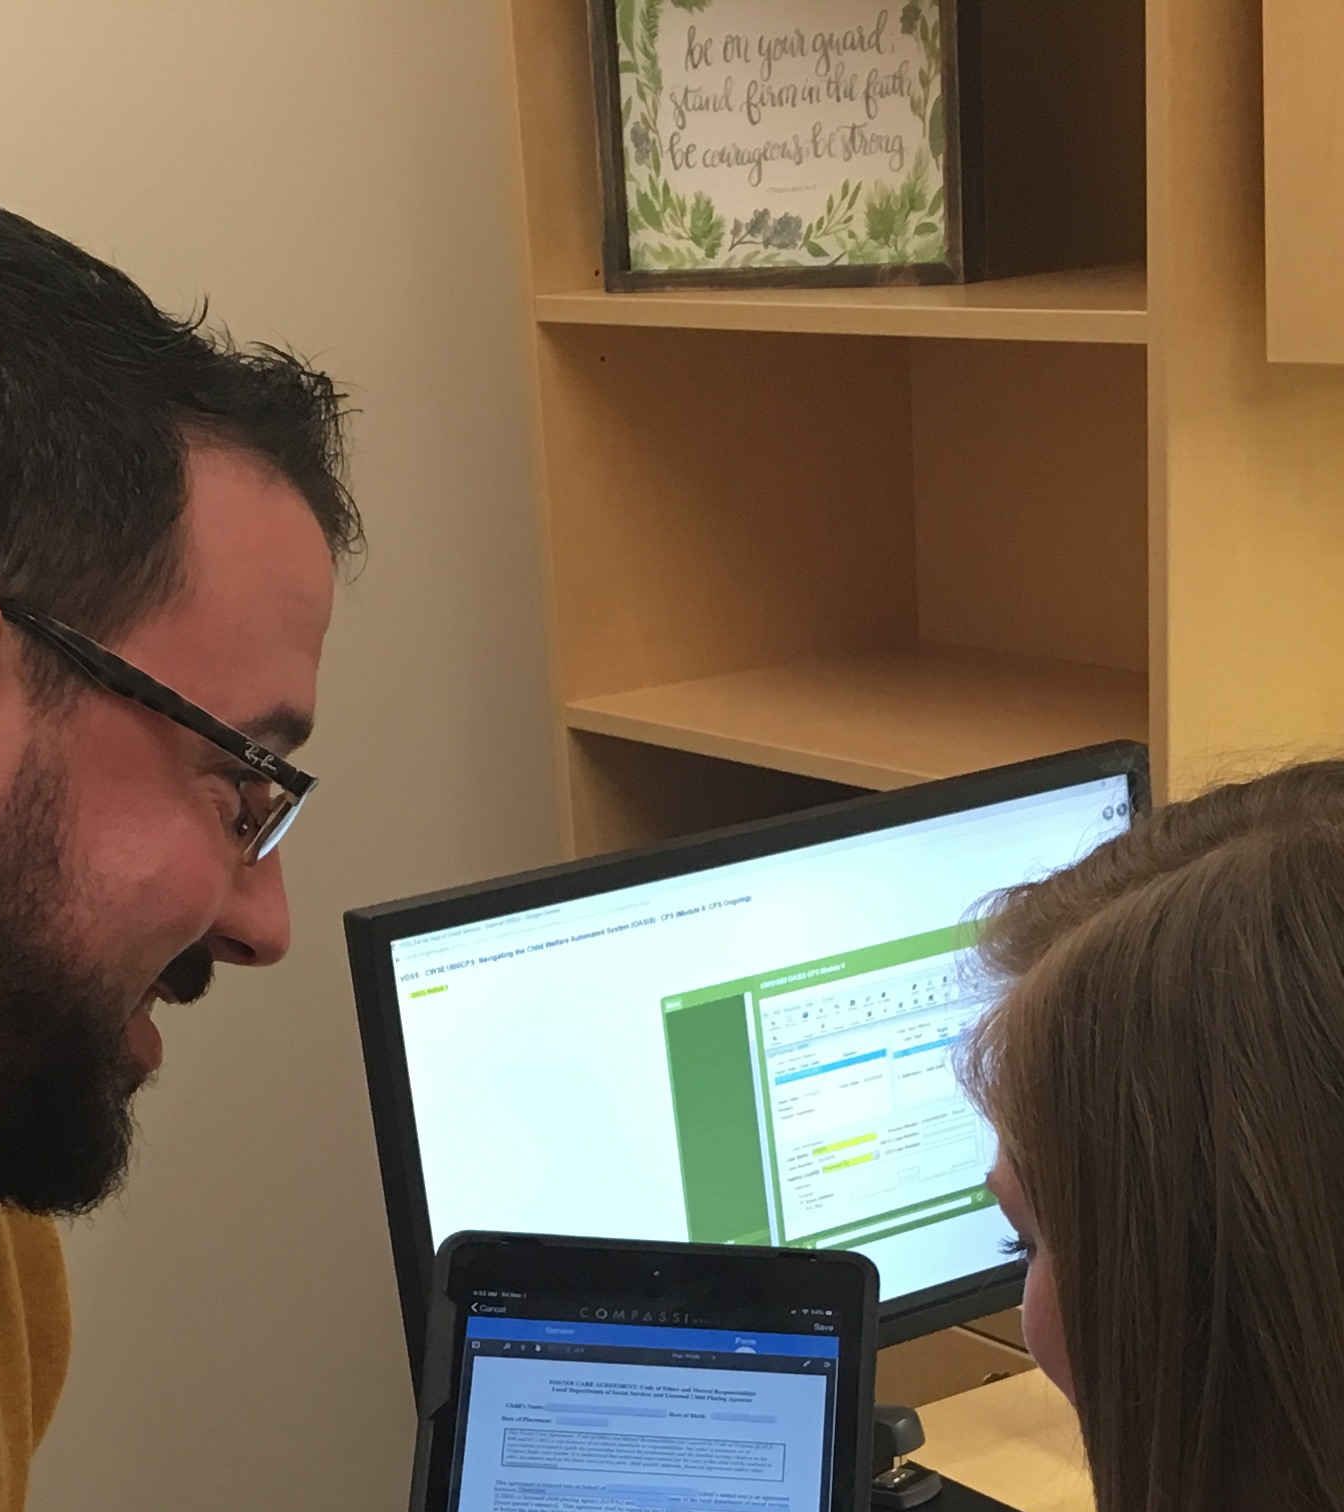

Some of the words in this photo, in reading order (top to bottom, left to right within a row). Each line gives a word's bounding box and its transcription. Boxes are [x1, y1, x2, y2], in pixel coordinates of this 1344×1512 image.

[685, 24, 713, 72] be
[723, 34, 750, 63] on
[758, 28, 807, 82] your
[669, 75, 734, 130] stand
[740, 80, 797, 125] firm
[801, 78, 821, 105] in
[824, 61, 858, 103] the
[668, 131, 698, 171] be
[811, 121, 837, 158] be
[399, 970, 419, 983] VDSS
[478, 949, 514, 966] Navigating
[514, 946, 525, 956] the
[526, 941, 544, 953] Child
[545, 936, 569, 949] Welfare
[569, 927, 605, 943] Automated
[606, 922, 630, 935] System
[660, 911, 674, 922] CPS
[708, 900, 722, 911] CPS
[722, 893, 752, 908] Ongoing)
[479, 1304, 507, 1314] Cancel
[813, 1322, 834, 1332] Save
